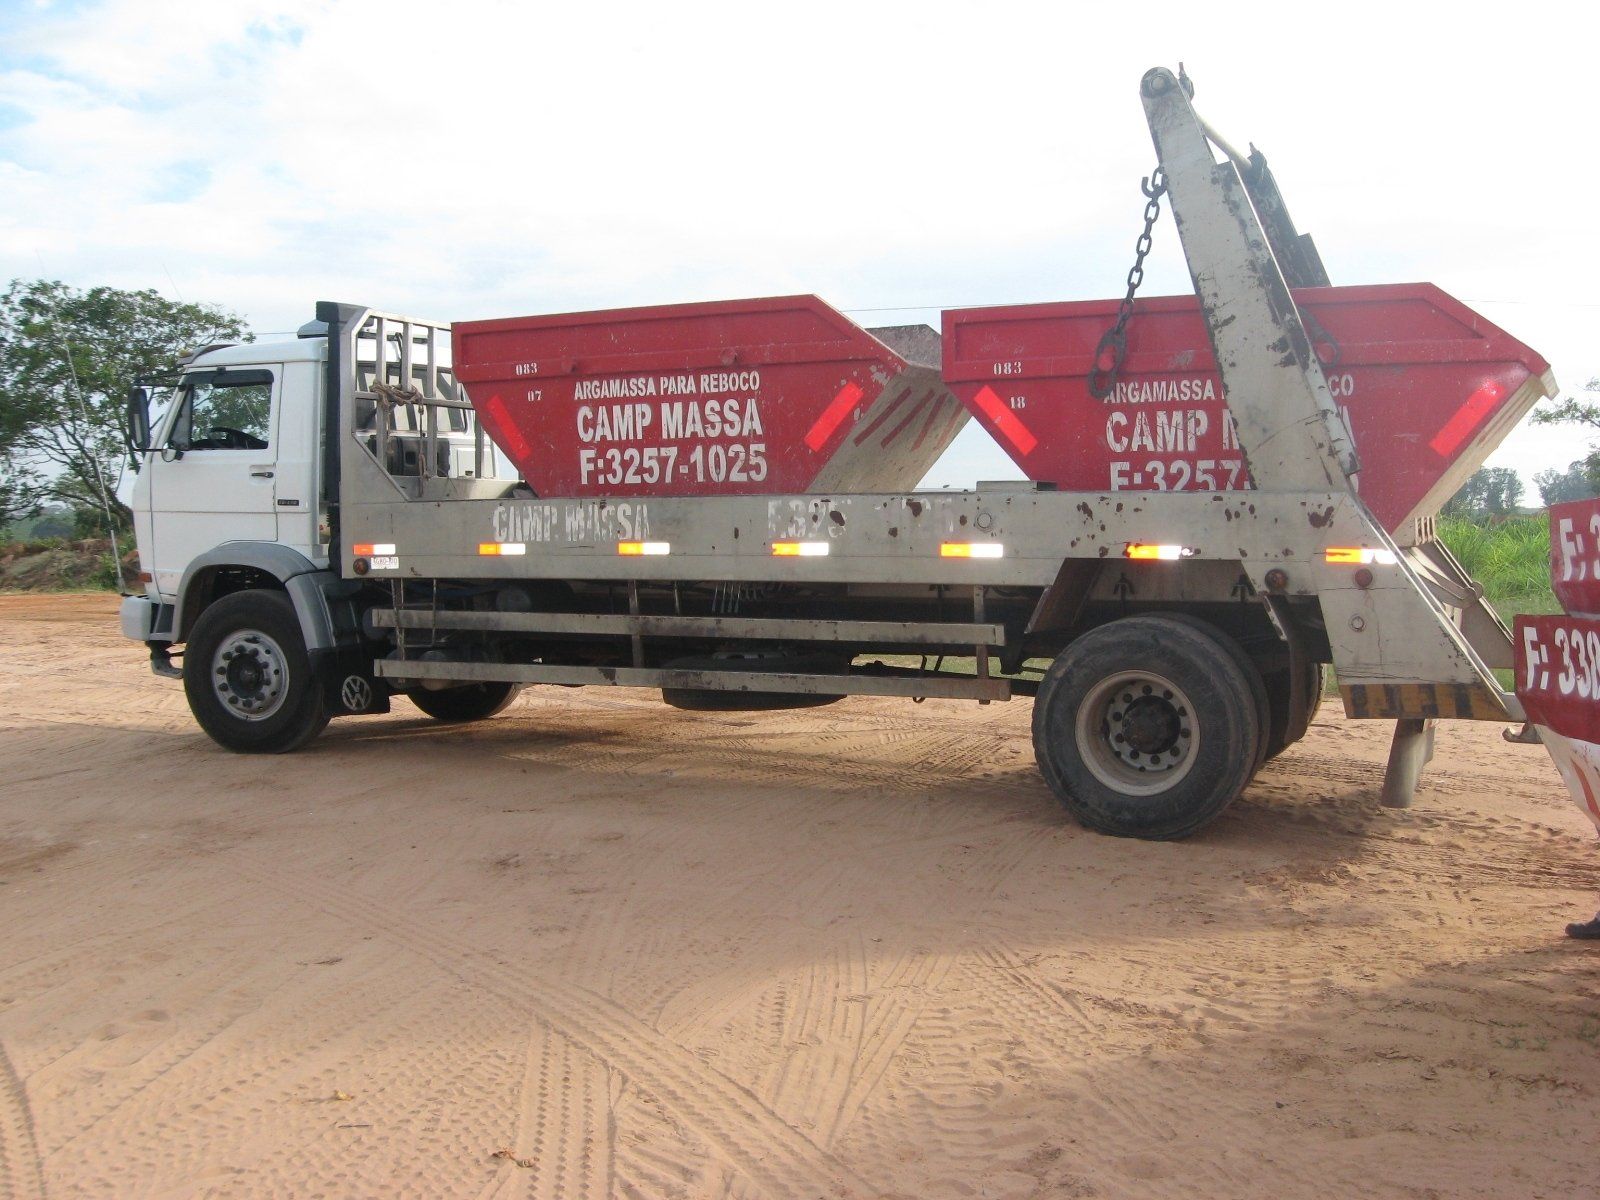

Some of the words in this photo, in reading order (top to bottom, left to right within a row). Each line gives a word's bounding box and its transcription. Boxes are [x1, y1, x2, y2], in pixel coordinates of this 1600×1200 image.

[515, 363, 538, 376] 083
[993, 361, 1022, 376] 083
[527, 390, 543, 402] 07
[574, 377, 656, 400] ARGAMASSA
[660, 374, 696, 396] PARA
[700, 371, 760, 394] REBOCO
[1104, 379, 1214, 404] ARGAMASSA
[1009, 396, 1026, 410] 18
[577, 402, 652, 443] CAMP
[661, 399, 763, 439] MASSA
[1106, 410, 1208, 452] CAMP
[580, 444, 768, 486] F:3257-1025
[493, 504, 558, 542] CAMP
